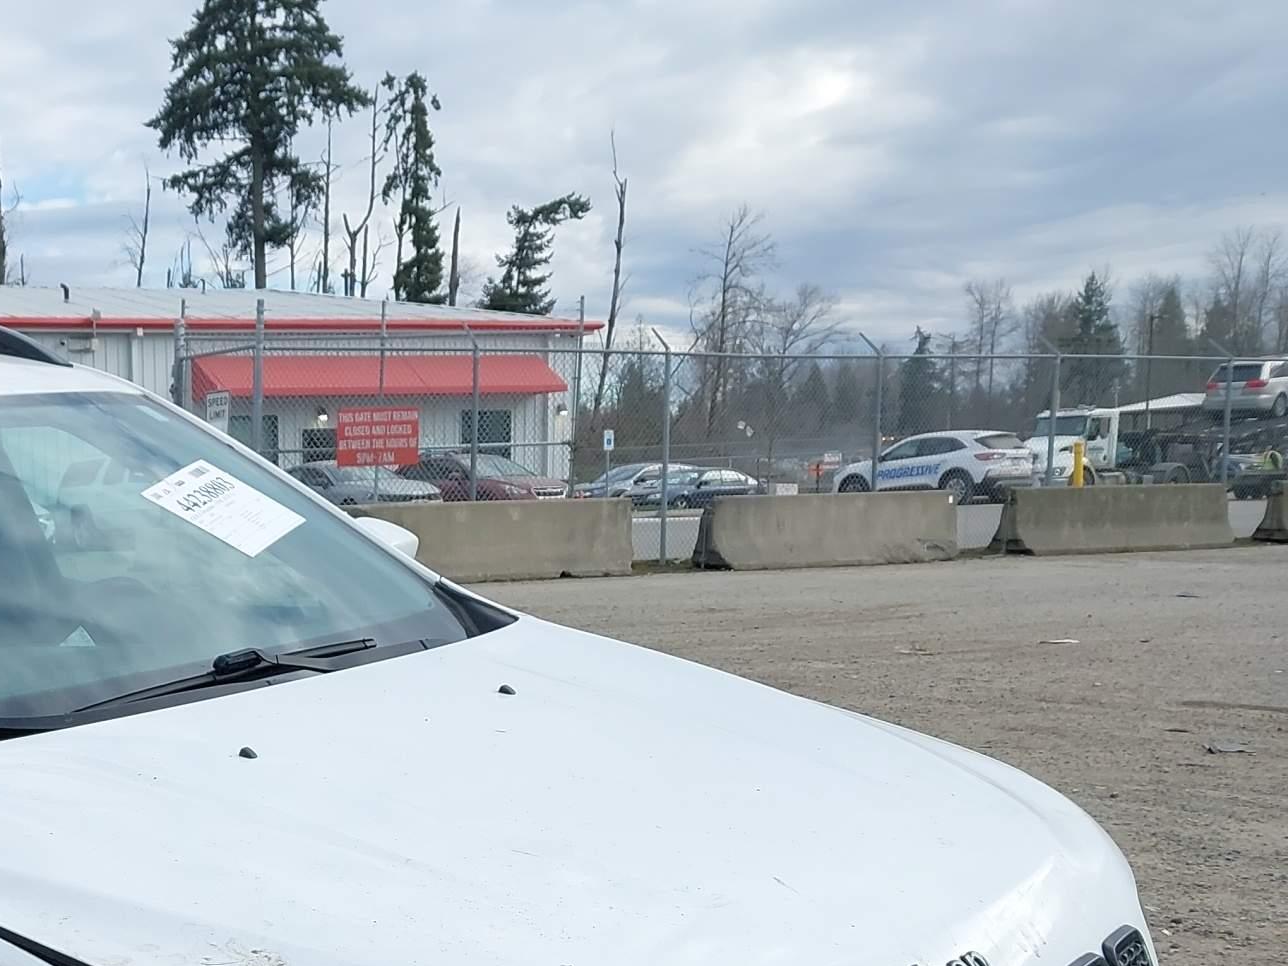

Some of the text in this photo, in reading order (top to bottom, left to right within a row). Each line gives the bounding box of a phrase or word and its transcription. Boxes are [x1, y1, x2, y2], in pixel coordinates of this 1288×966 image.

[207, 396, 228, 408] SPEED
[209, 409, 225, 420] LIMIT
[339, 410, 418, 423] THIS GATE MUST REMAIN
[345, 424, 412, 437] CLOSED AND LOCKED
[339, 438, 371, 450] BETWEEN
[372, 438, 385, 449] THE
[386, 438, 409, 448] HOURS
[877, 463, 941, 480] PROGRESSIVE
[176, 477, 236, 512] 44238803
